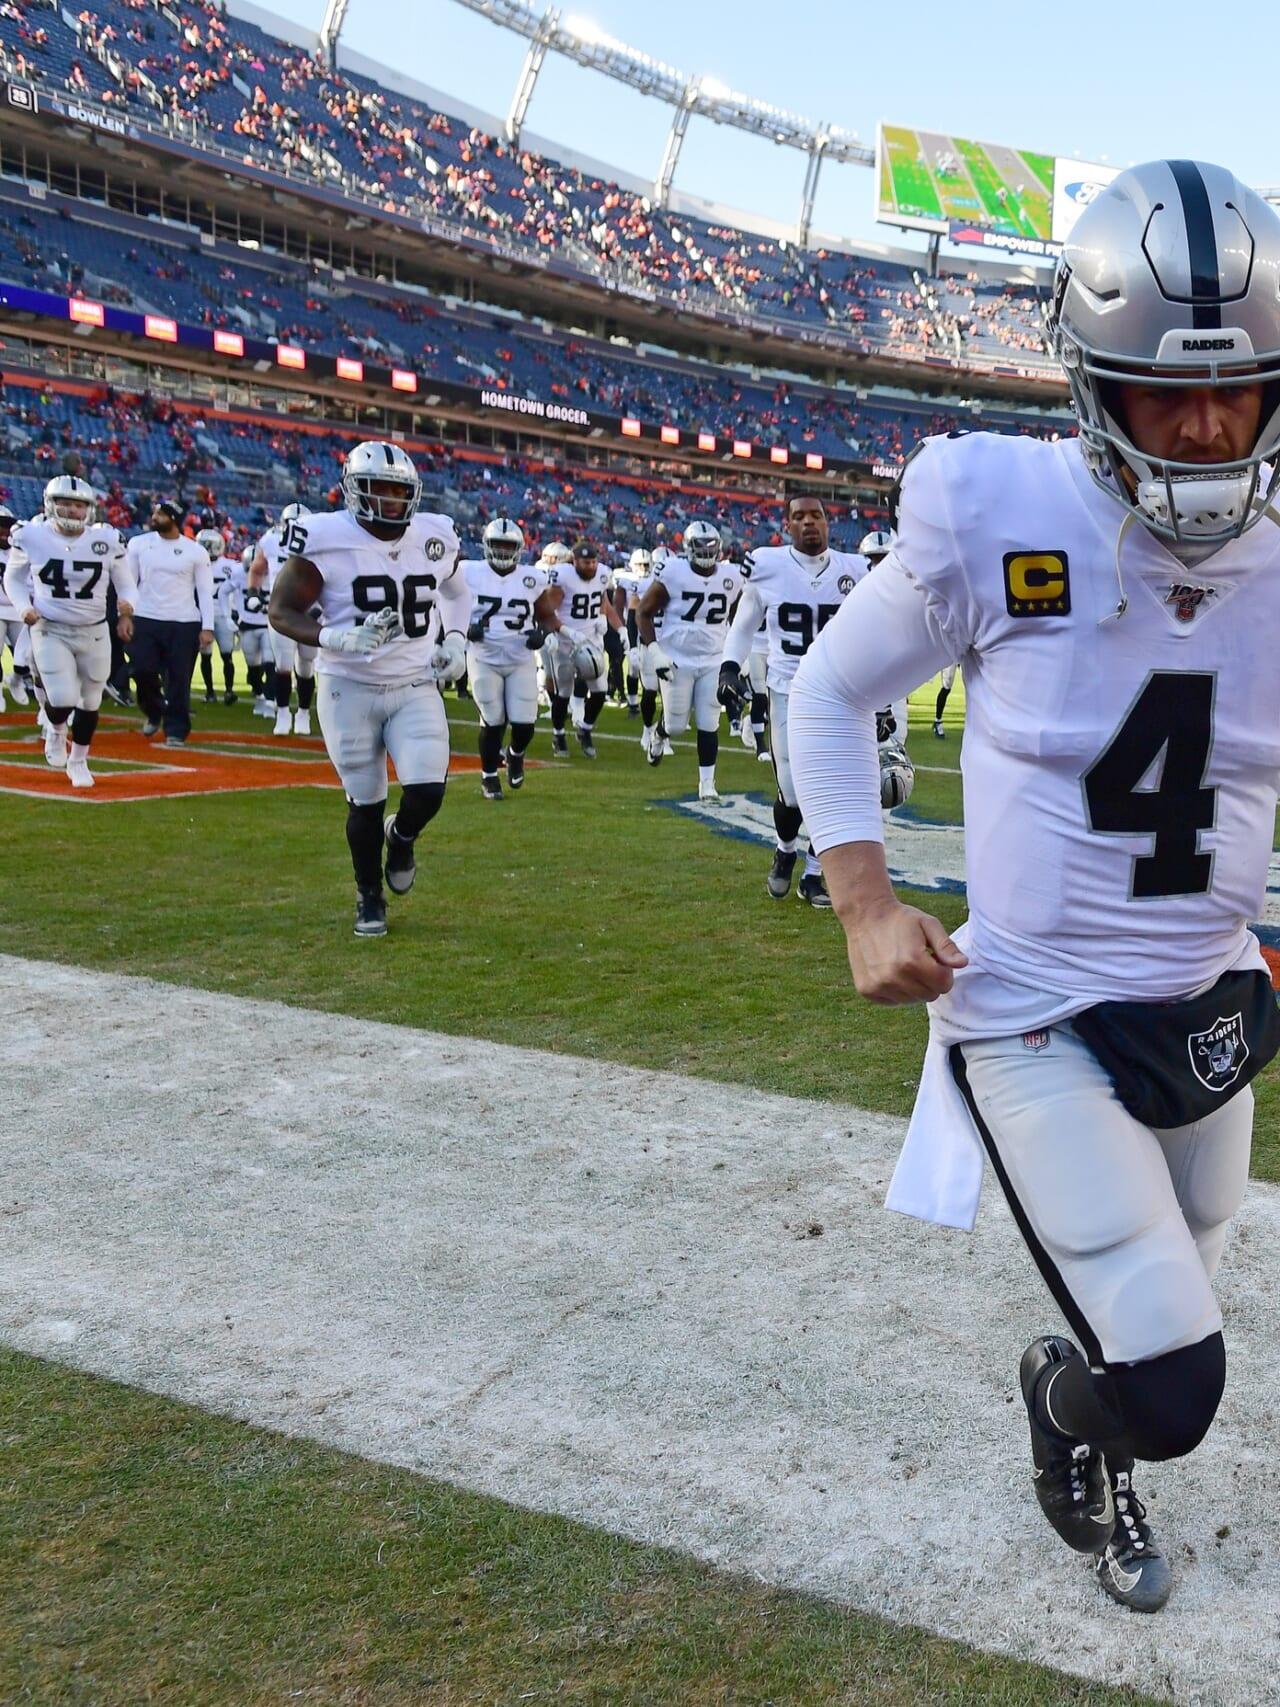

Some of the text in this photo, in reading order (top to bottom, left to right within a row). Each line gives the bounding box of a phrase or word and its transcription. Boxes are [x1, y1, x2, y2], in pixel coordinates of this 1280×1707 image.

[68, 105, 126, 135] BOWLEN
[983, 232, 1045, 254] EMPOWER
[1182, 339, 1235, 351] RAIDERS
[481, 390, 591, 426] HOMETOWN GROCER.
[428, 543, 441, 556] 60
[38, 558, 103, 600] 47
[840, 579, 853, 591] 60
[1008, 557, 1064, 600] C
[352, 574, 437, 639] 96
[477, 595, 531, 630] 73
[570, 592, 602, 620] 82
[680, 591, 728, 625] 72
[1079, 668, 1218, 902] 4
[1024, 1031, 1047, 1047] NFL
[1197, 1019, 1237, 1044] RAIDERS
